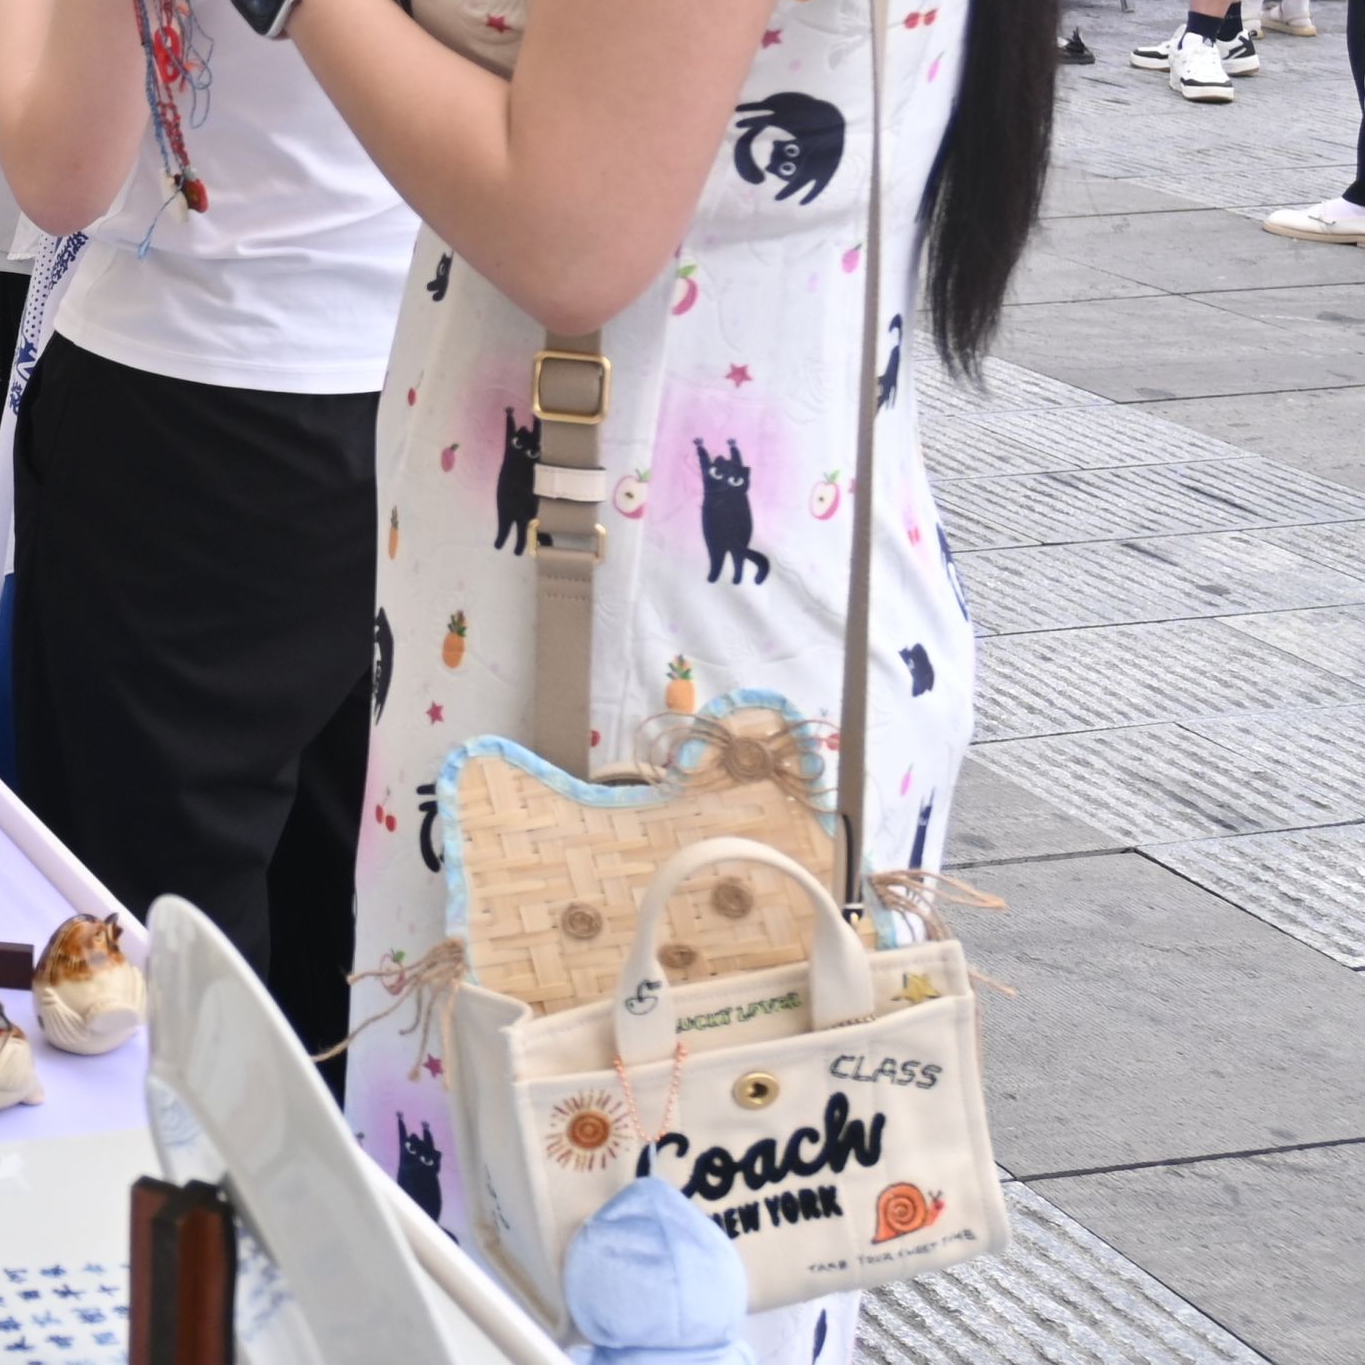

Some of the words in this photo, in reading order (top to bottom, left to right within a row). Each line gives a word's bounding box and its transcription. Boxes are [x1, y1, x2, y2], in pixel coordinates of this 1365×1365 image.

[829, 1054, 943, 1090] CLASS
[635, 1091, 886, 1202] Coach
[764, 1184, 844, 1227] YORK
